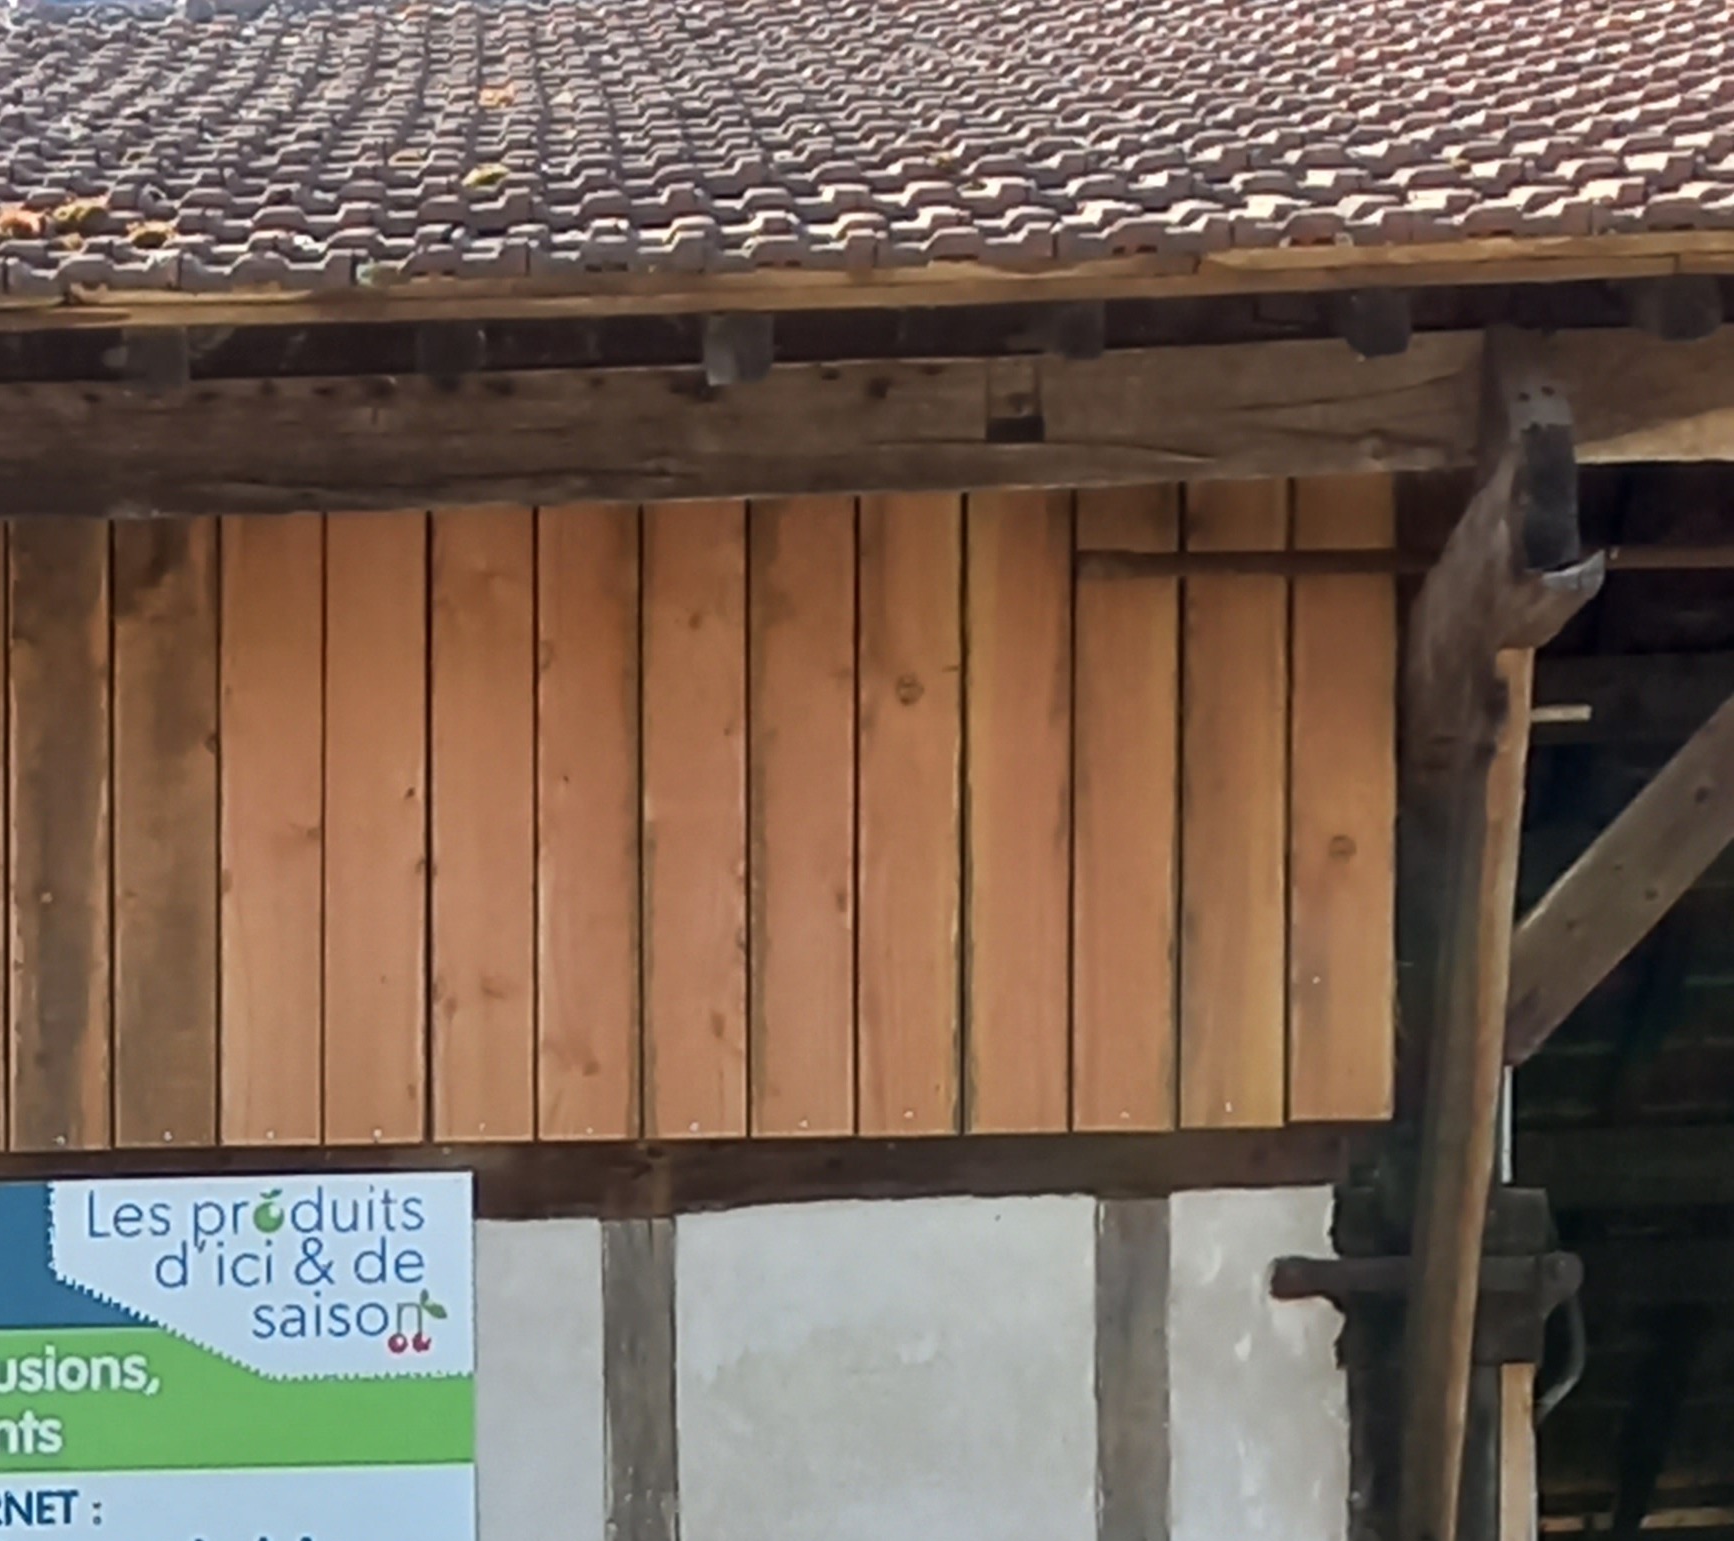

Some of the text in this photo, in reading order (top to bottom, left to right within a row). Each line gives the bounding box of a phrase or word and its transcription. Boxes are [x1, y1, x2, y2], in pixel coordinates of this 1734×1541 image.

[88, 1184, 426, 1247] Les produits
[155, 1234, 426, 1289] d'ici & de
[252, 1291, 431, 1353] saison
